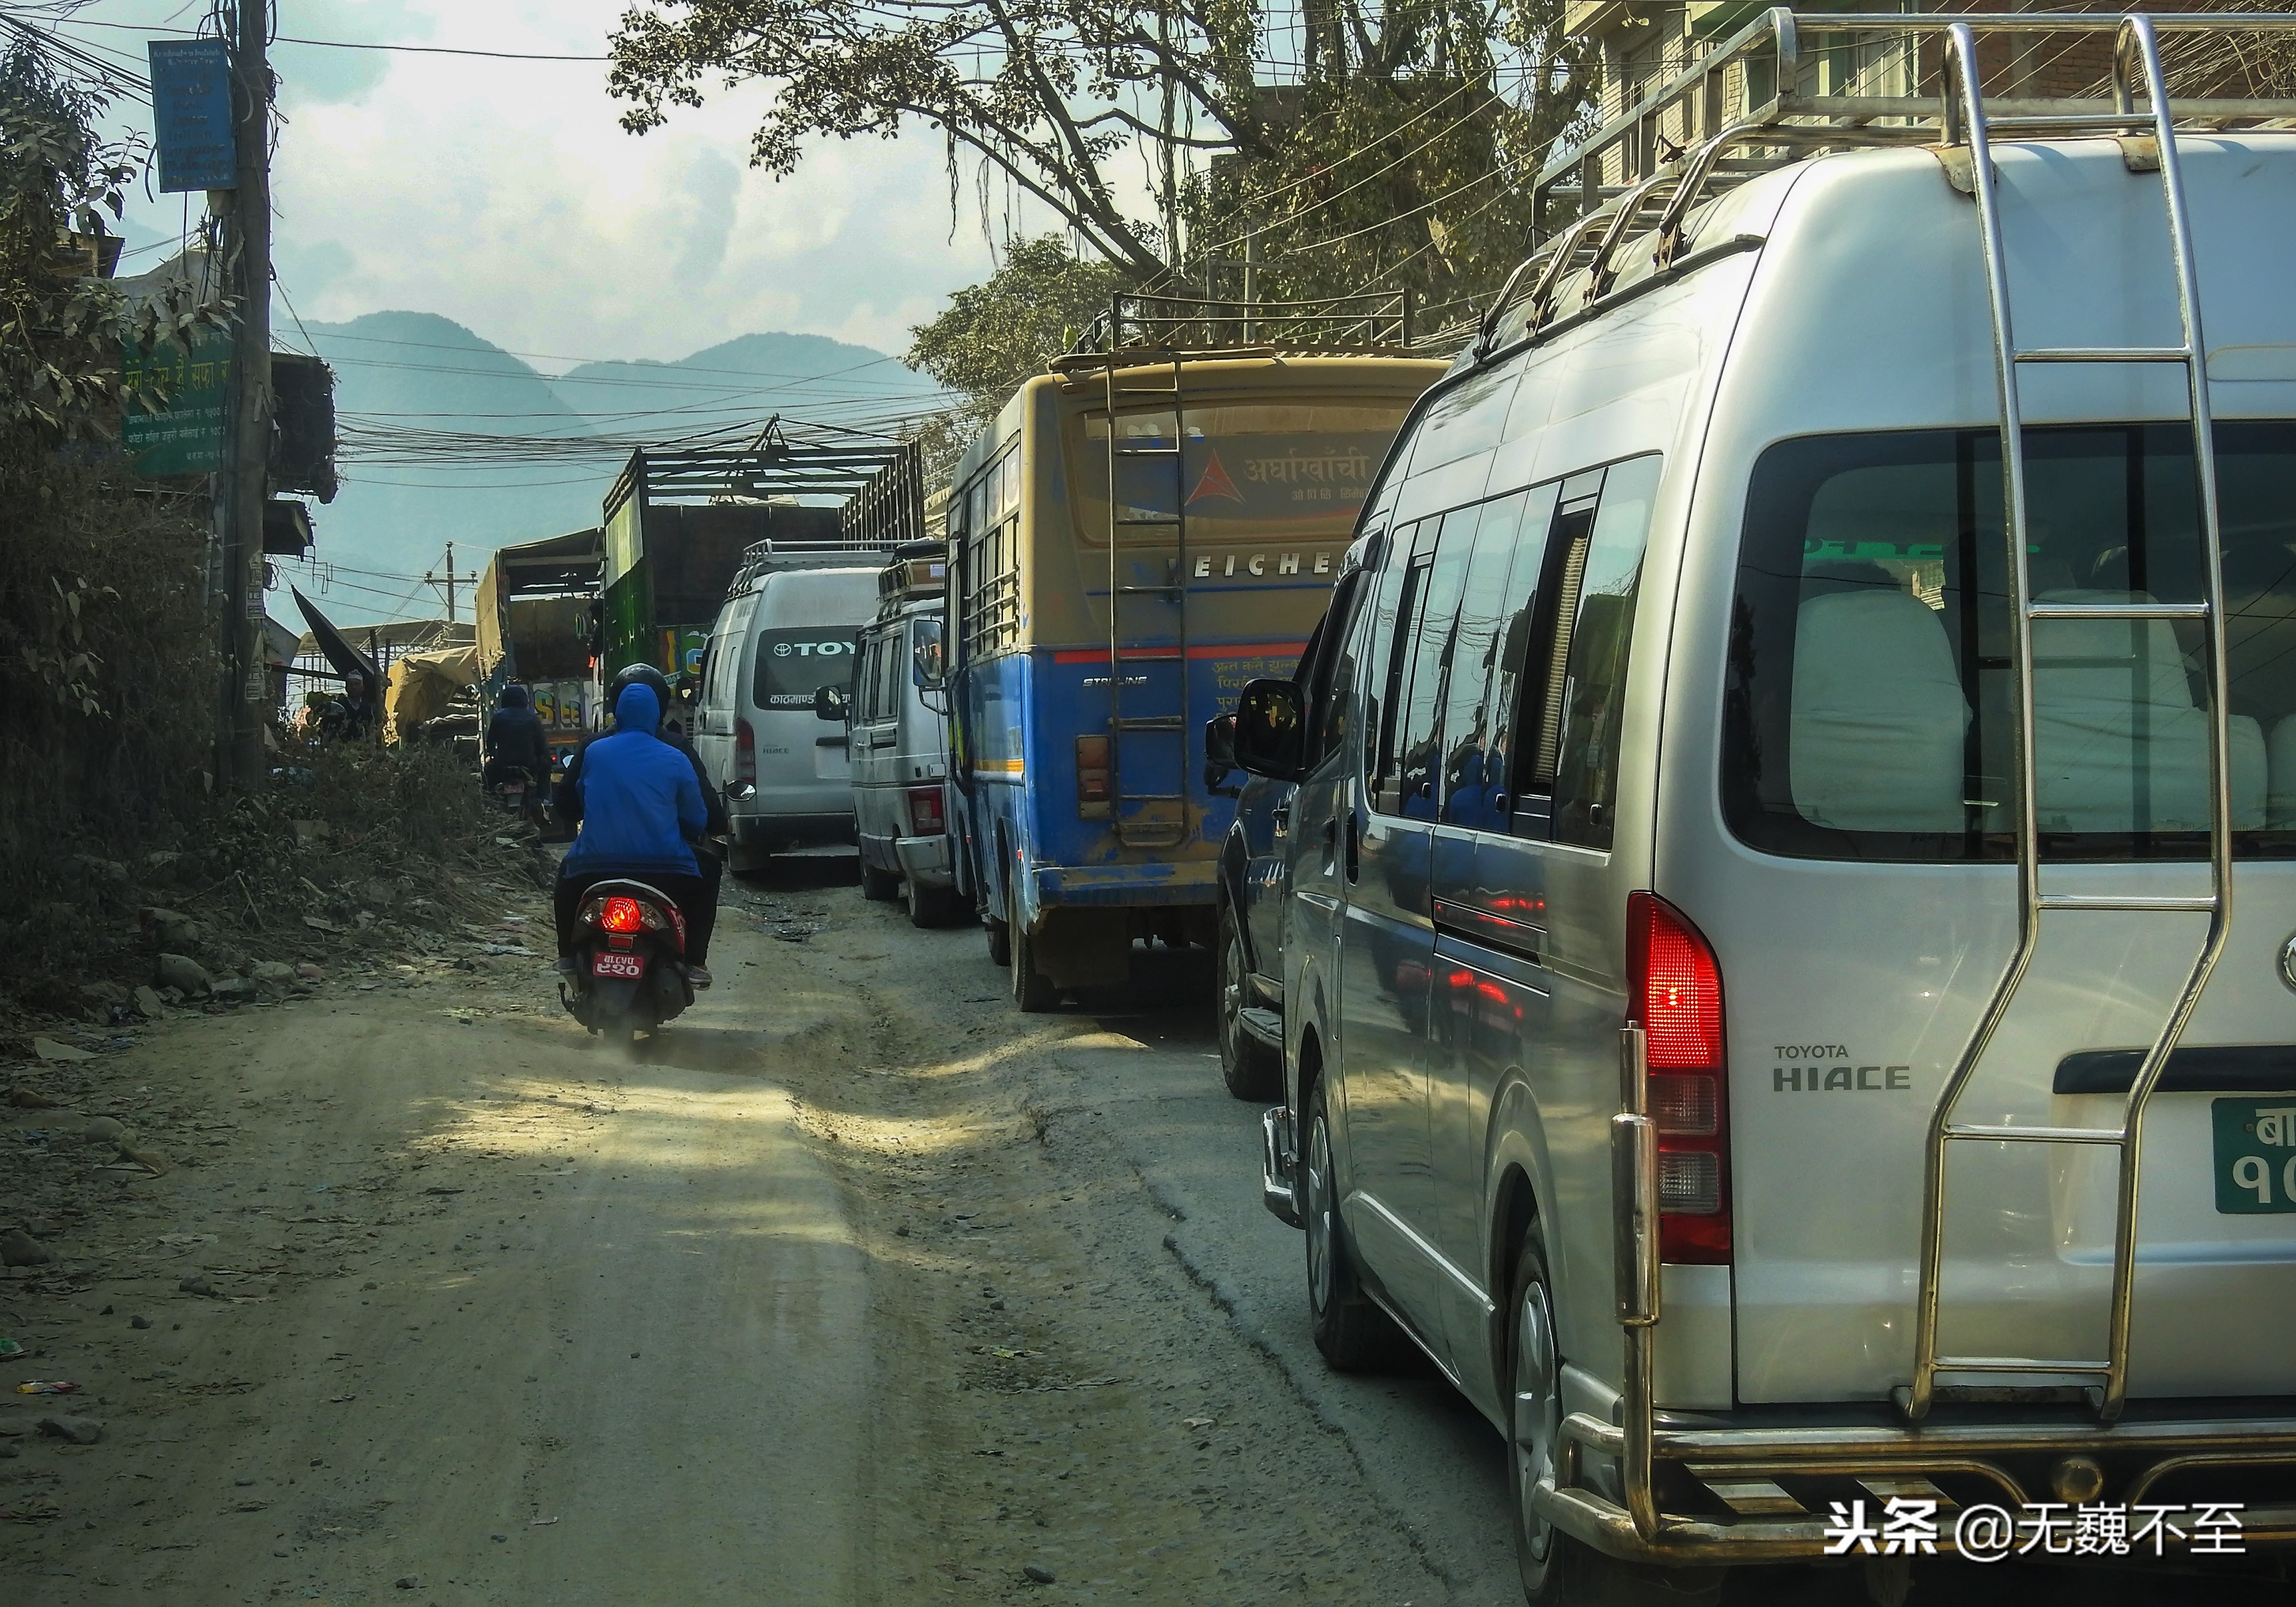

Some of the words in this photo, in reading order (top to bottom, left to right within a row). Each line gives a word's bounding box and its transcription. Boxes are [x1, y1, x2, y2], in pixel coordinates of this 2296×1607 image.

[1194, 552, 1330, 577] EICHE
[794, 642, 856, 656] TOY
[770, 692, 816, 704] काठमाण्ड
[1774, 1044, 1848, 1059] TOYOTA
[1773, 1066, 1910, 1091] HIACE
[2255, 1107, 2296, 1147] बा
